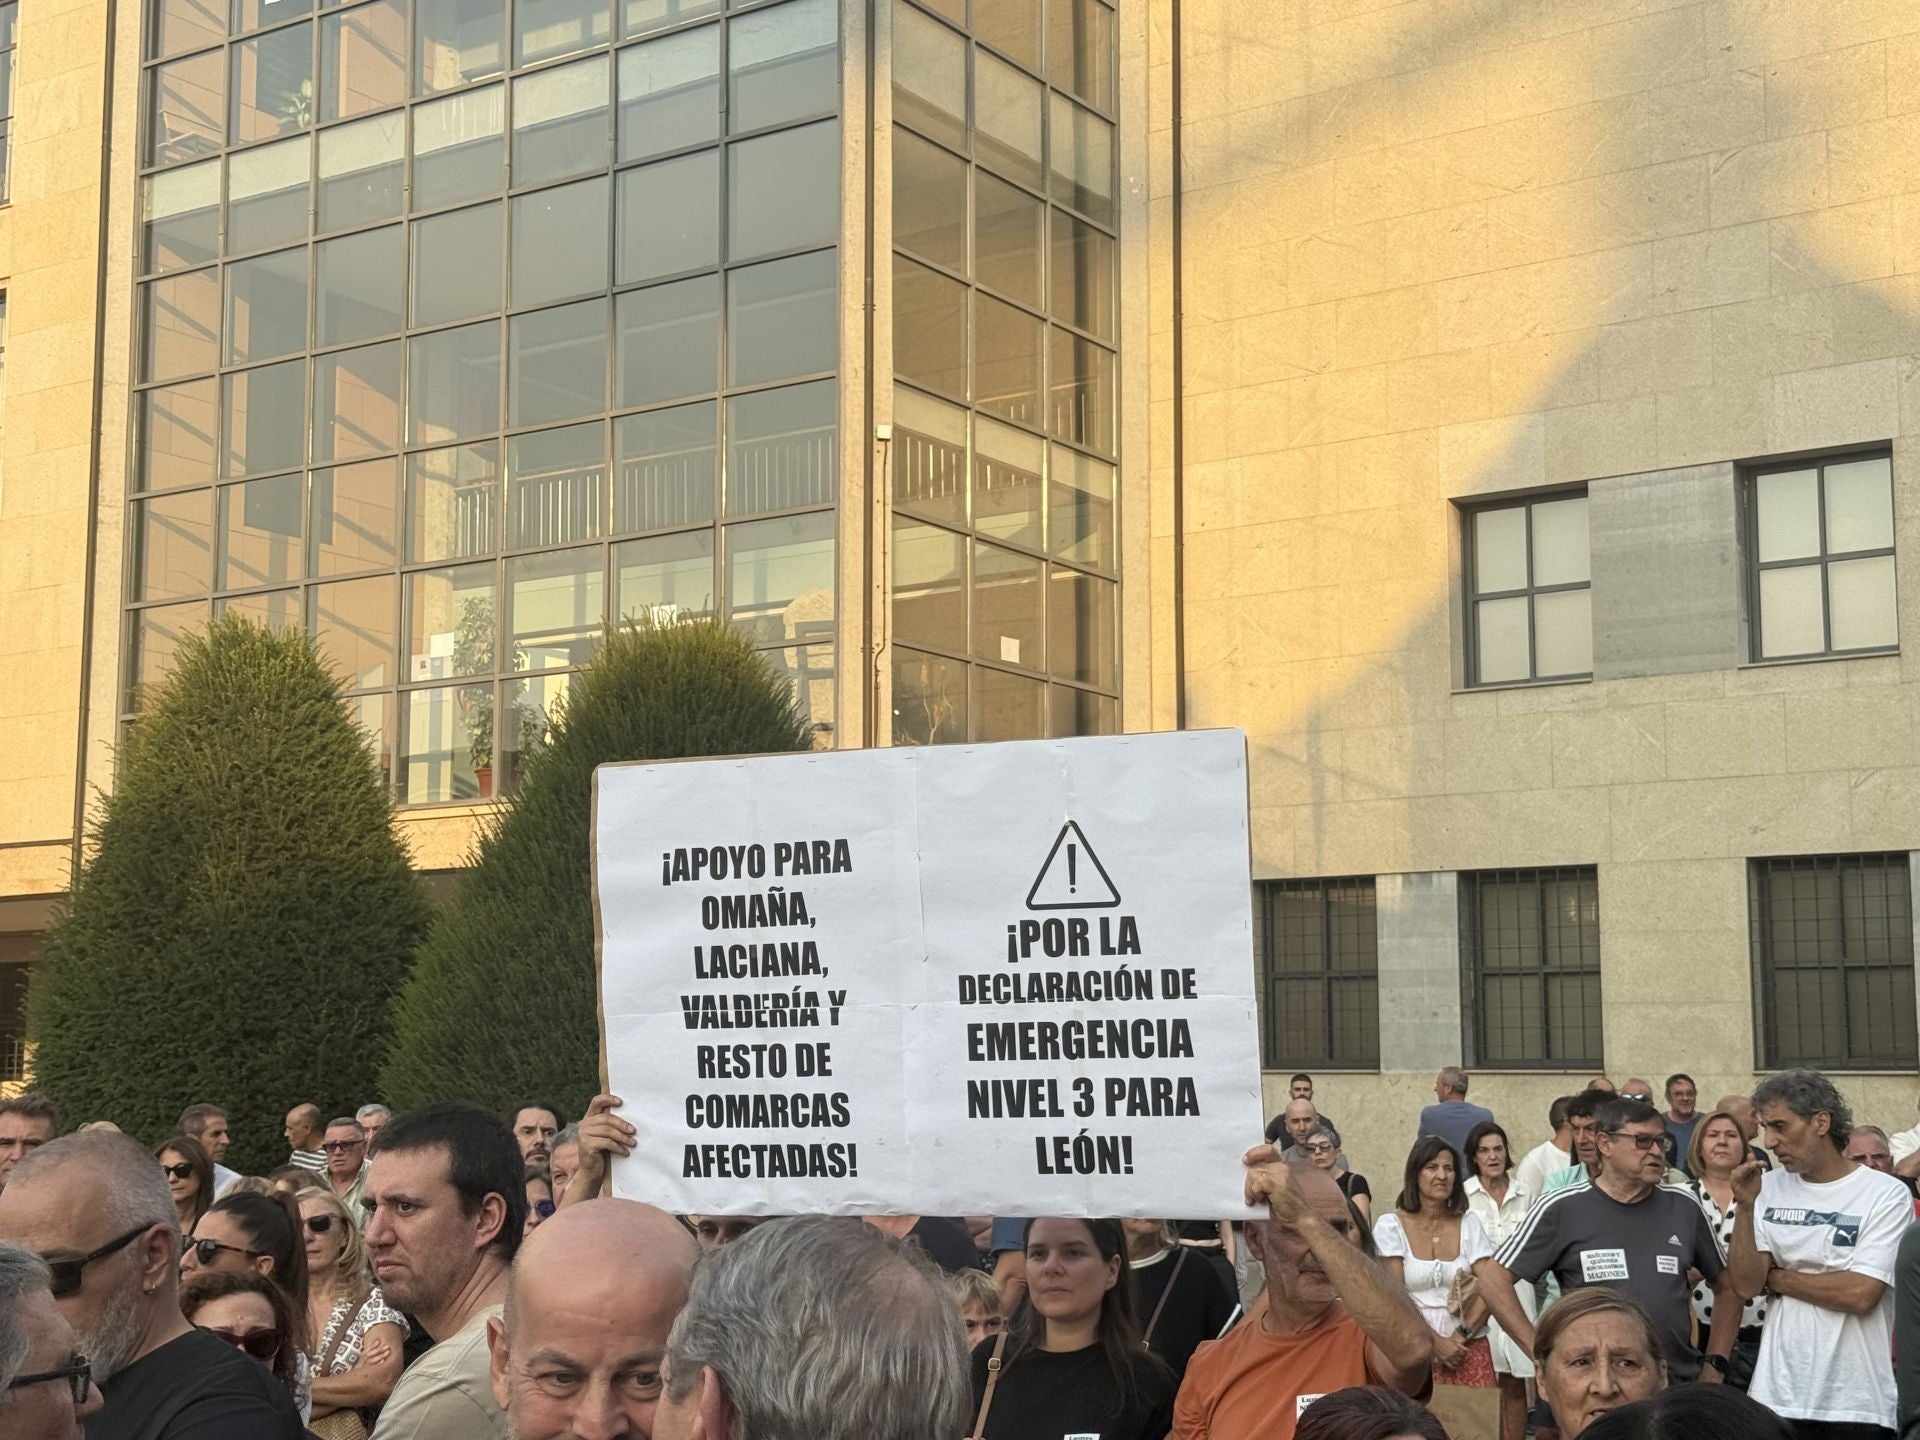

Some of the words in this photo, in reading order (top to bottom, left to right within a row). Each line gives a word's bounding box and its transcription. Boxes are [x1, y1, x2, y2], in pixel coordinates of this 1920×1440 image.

[662, 843, 766, 886] ¡APOYO
[774, 838, 853, 877] PARA
[701, 887, 817, 931] OMAÑA,
[693, 941, 829, 979] LACIANA,
[1007, 917, 1090, 963] ¡POR
[1099, 915, 1142, 956] LA
[958, 963, 1154, 1005] DECLARACIÓN
[1160, 968, 1198, 1000] DE
[680, 985, 820, 1030] VALDERÍA
[827, 989, 847, 1026] Y
[697, 1043, 787, 1079] RESTO
[795, 1042, 833, 1078] DE
[967, 1018, 1195, 1062] EMERGENCIA
[685, 1092, 851, 1129] COMARCAS
[967, 1078, 1065, 1119] NIVEL
[1072, 1077, 1095, 1118] 3
[1104, 1077, 1201, 1117] PARA
[682, 1142, 858, 1179] AFECTADAS!
[1035, 1128, 1134, 1175] LEÓN!
[1773, 1209, 1806, 1222] PUMA
[1587, 1270, 1626, 1280] MAZONES
